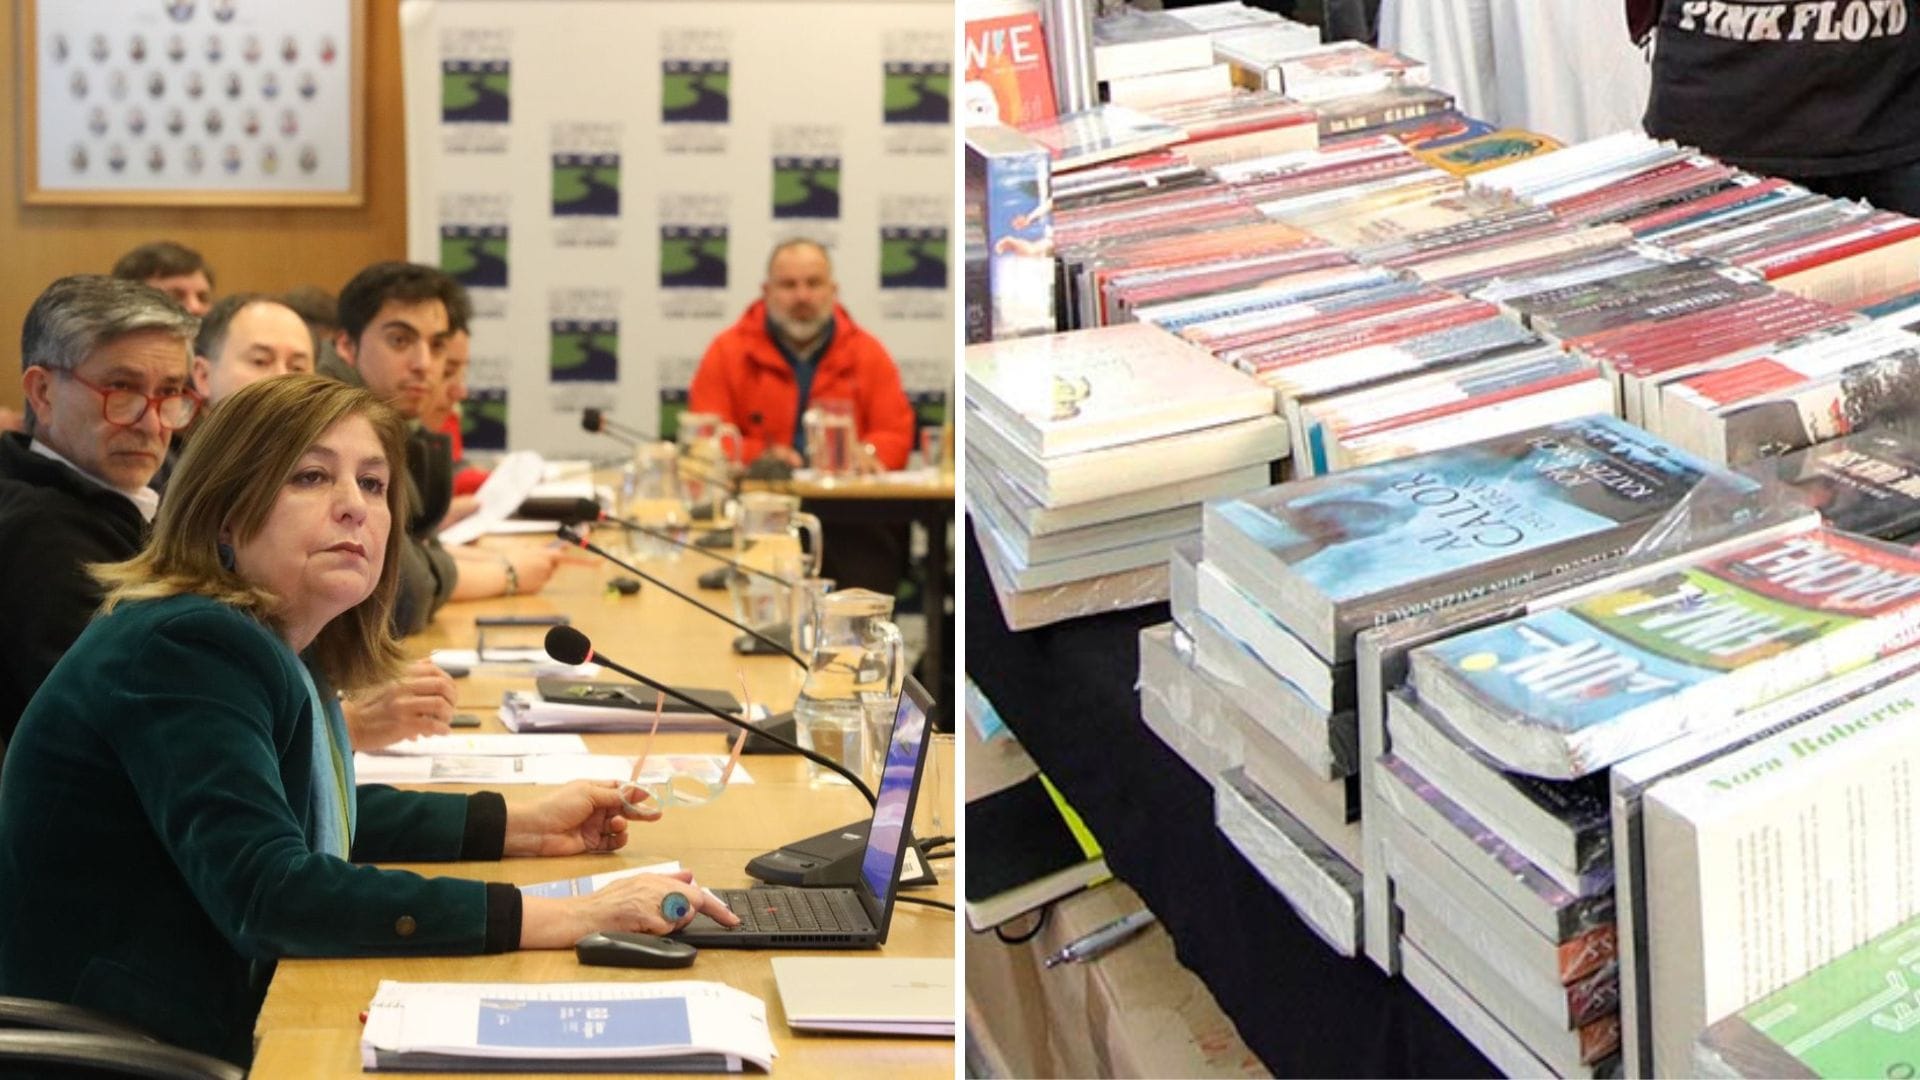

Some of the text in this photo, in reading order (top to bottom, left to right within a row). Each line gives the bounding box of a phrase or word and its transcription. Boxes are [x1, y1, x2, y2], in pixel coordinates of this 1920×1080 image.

[1679, 0, 1908, 41] PINK FLOYD
[1391, 471, 1525, 547] CALOR
[1420, 529, 1470, 551] AL
[1615, 582, 1812, 657] FINAL
[1501, 638, 1641, 700] UN
[1706, 697, 1916, 791] Nora Roberts
